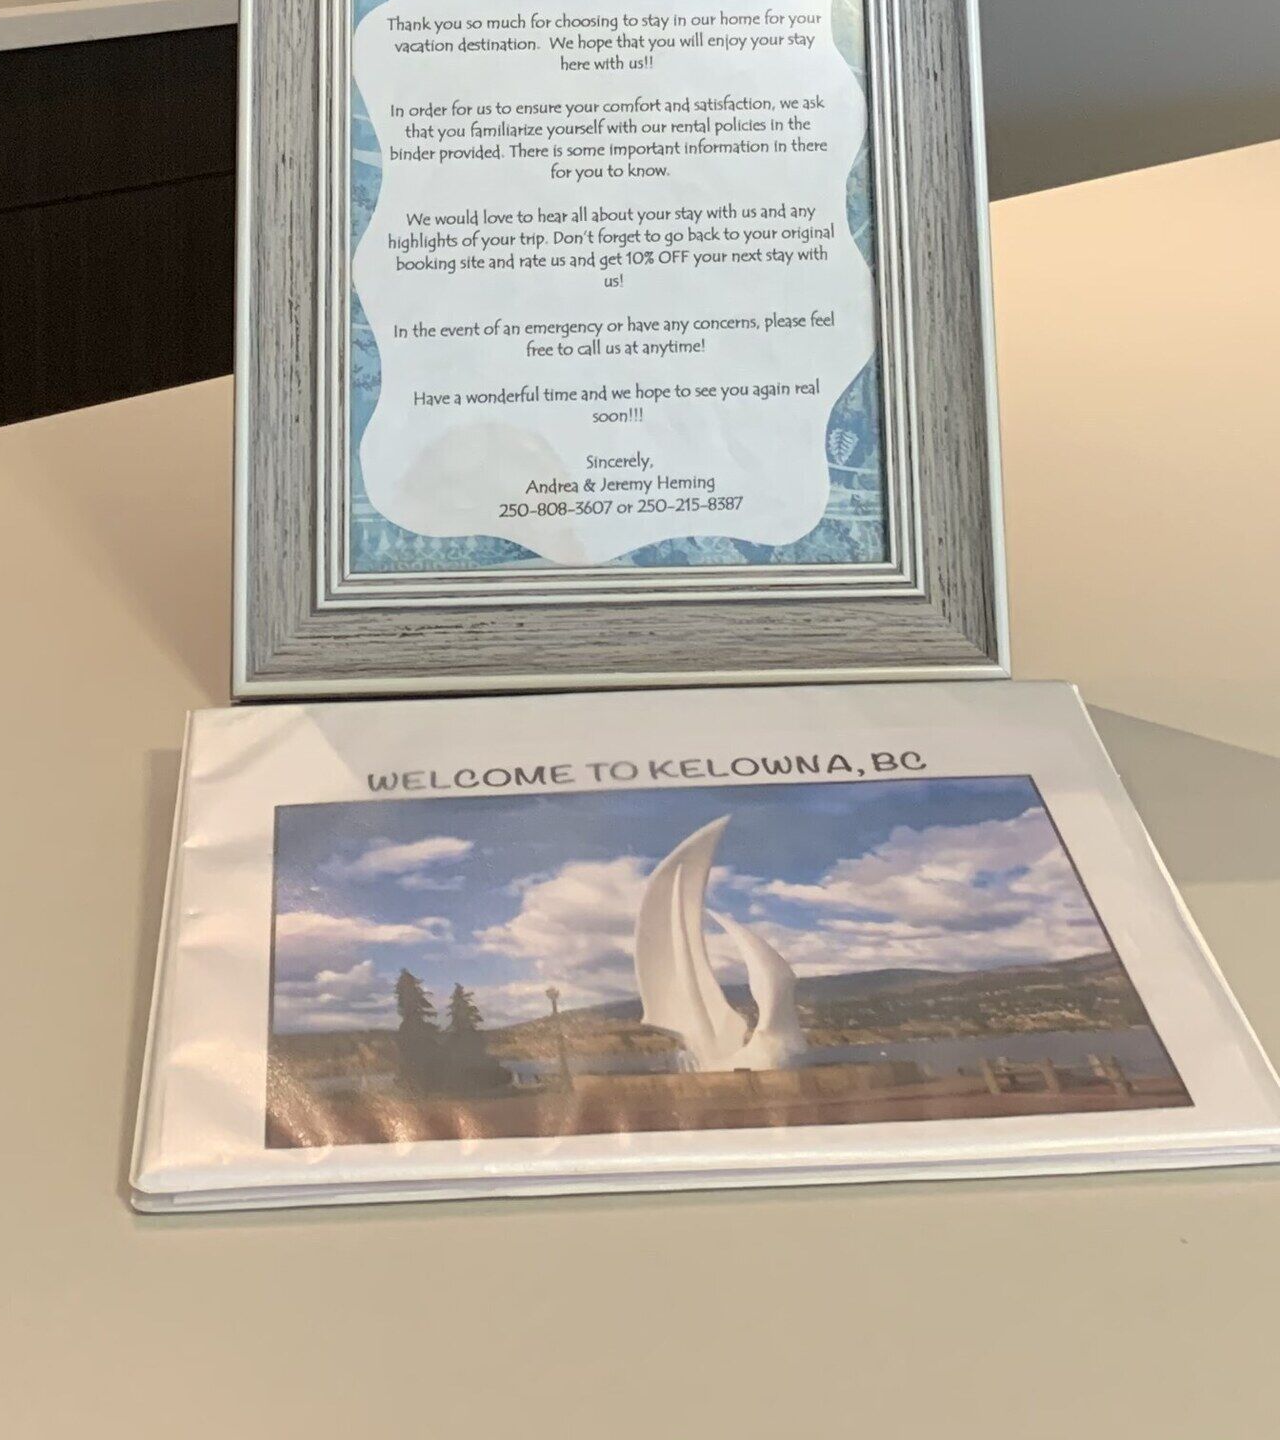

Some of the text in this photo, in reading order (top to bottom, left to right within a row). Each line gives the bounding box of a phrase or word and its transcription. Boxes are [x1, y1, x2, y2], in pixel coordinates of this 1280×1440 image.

[386, 8, 822, 35] Thank you so much for choosing to stay in our home for your
[393, 31, 816, 54] vacation destination. We hope that you will enjoy your stay
[559, 53, 653, 71] here with us!!
[390, 93, 825, 119] In order for us to ensure your comfort and satisfaction, we ask
[404, 114, 811, 143] that you familiarize yourself with our rental policies in the
[389, 135, 828, 164] binder provided. There is some important information in there
[550, 161, 670, 183] for you to know.
[405, 202, 817, 227] We would love to hear all about your stay with us and any
[387, 221, 835, 254] highlights of your trip. Don't forget to go back to your original
[395, 244, 828, 275] booking site and rate us and get 10% OFF your next stay with
[603, 273, 623, 288] us!
[393, 309, 835, 339] In the event of an emergency or have any concerns, please feel
[525, 337, 705, 358] free to call us at anytime!
[413, 377, 820, 407] Have a wonderful time and we hope to see you again real
[592, 406, 643, 423] soon!!!
[585, 450, 654, 472] Sincerely,
[524, 474, 716, 495] Andrea & Jeremy Heming
[498, 495, 744, 518] 250-808-3607 or 250-215-8387
[367, 750, 927, 794] WELCOME TO KELOWNA, BC
